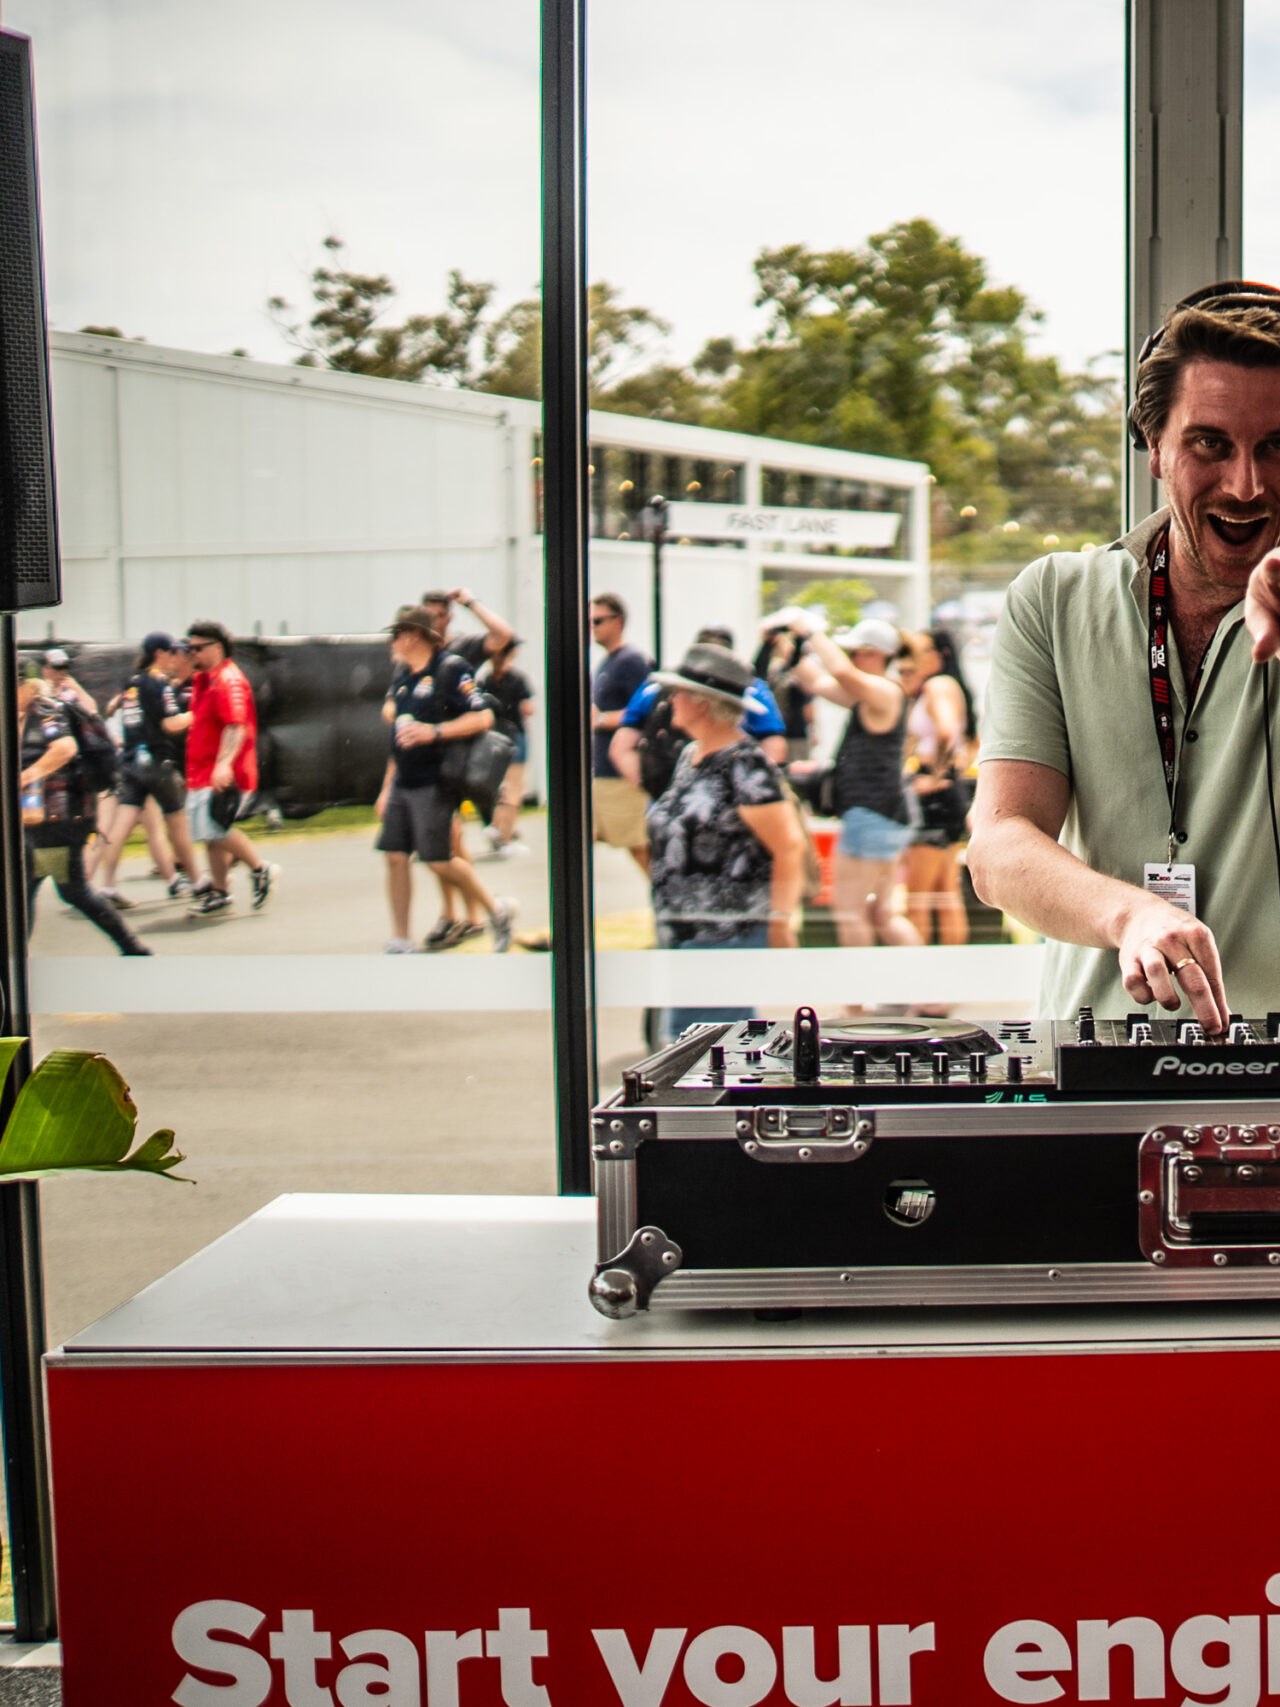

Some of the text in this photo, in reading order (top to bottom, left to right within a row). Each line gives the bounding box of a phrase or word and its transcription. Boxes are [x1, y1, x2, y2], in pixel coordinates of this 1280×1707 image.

[728, 512, 839, 535] FAST LANE
[1152, 1055, 1280, 1076] Pioneer
[170, 1598, 552, 1707] Start
[590, 1621, 936, 1707] your
